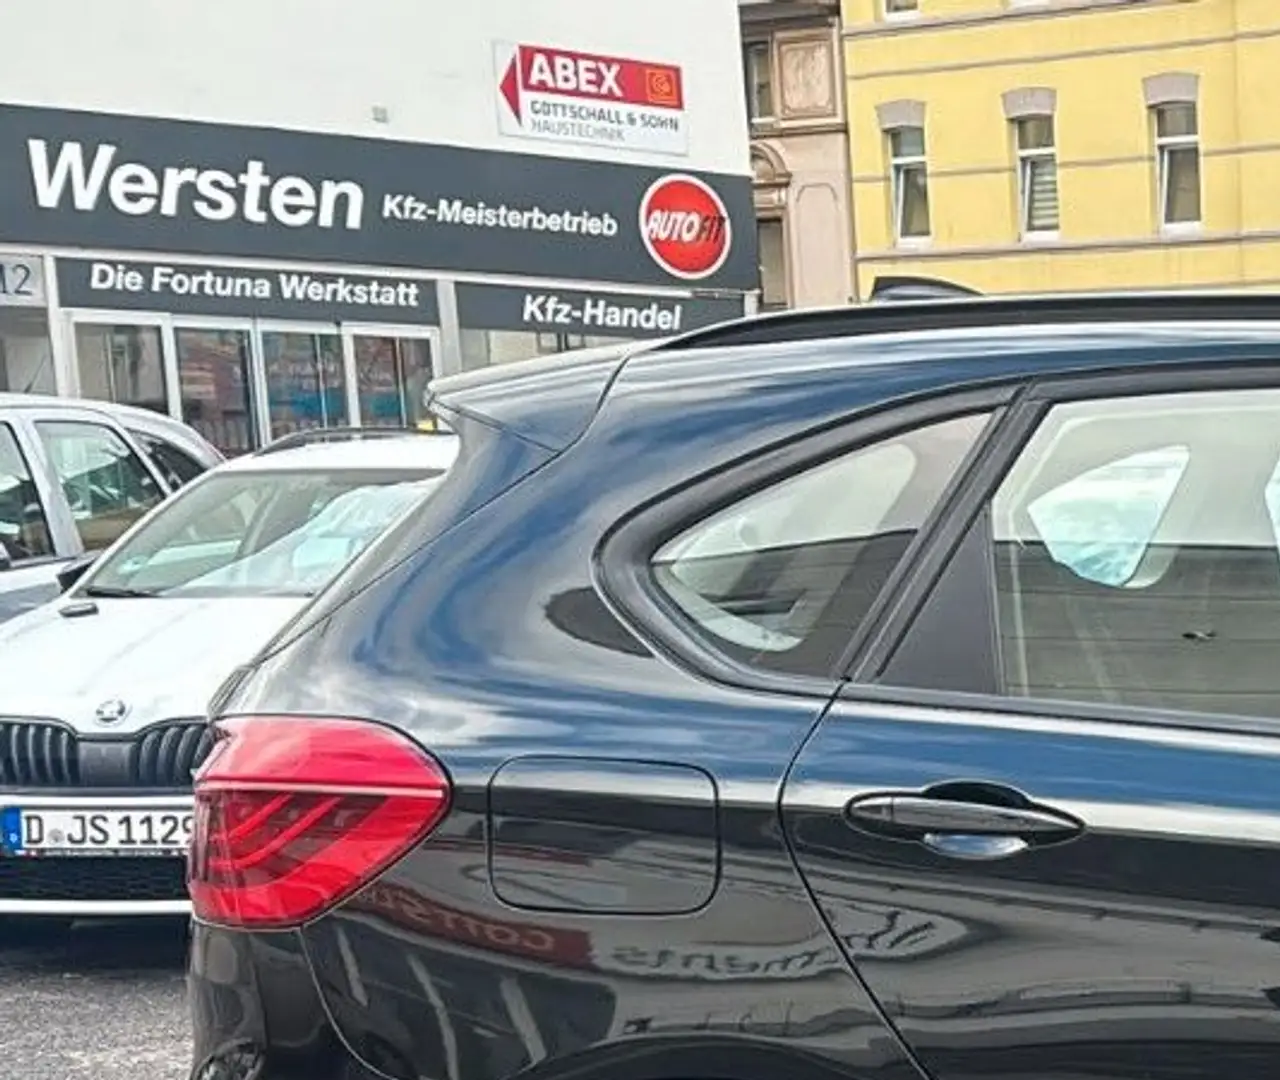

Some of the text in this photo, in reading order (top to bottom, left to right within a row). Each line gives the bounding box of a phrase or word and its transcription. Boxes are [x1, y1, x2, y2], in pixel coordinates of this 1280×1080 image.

[528, 52, 623, 98] ABEX
[530, 100, 623, 126] GOTTSCHALL
[641, 114, 679, 133] SOHN
[27, 138, 619, 237] Wersten Kfz-Meisterbetrieb
[91, 263, 420, 307] Die Fortuna Werkstatt
[523, 294, 682, 331] Kfz-Handel
[25, 814, 44, 845] D
[67, 814, 110, 845] JS
